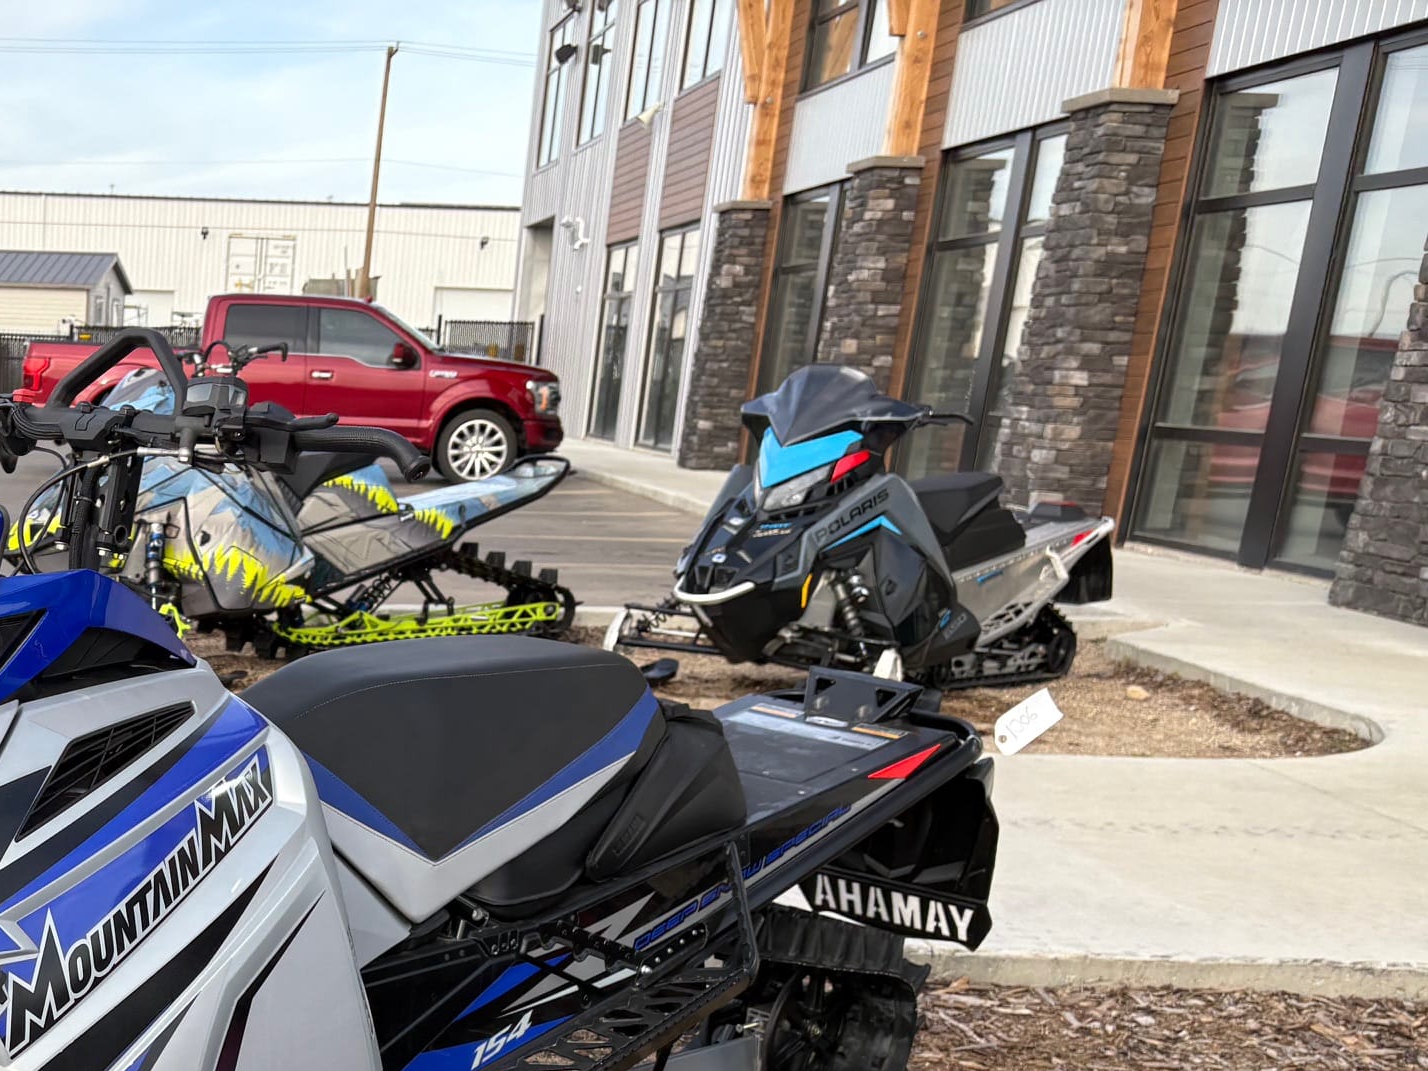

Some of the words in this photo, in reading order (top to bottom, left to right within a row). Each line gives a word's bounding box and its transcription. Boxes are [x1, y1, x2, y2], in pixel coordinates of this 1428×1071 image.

[814, 488, 890, 543] POLARIS
[633, 899, 700, 951] DEEP
[763, 804, 852, 867] SPECIAL
[471, 1009, 534, 1071] 154
